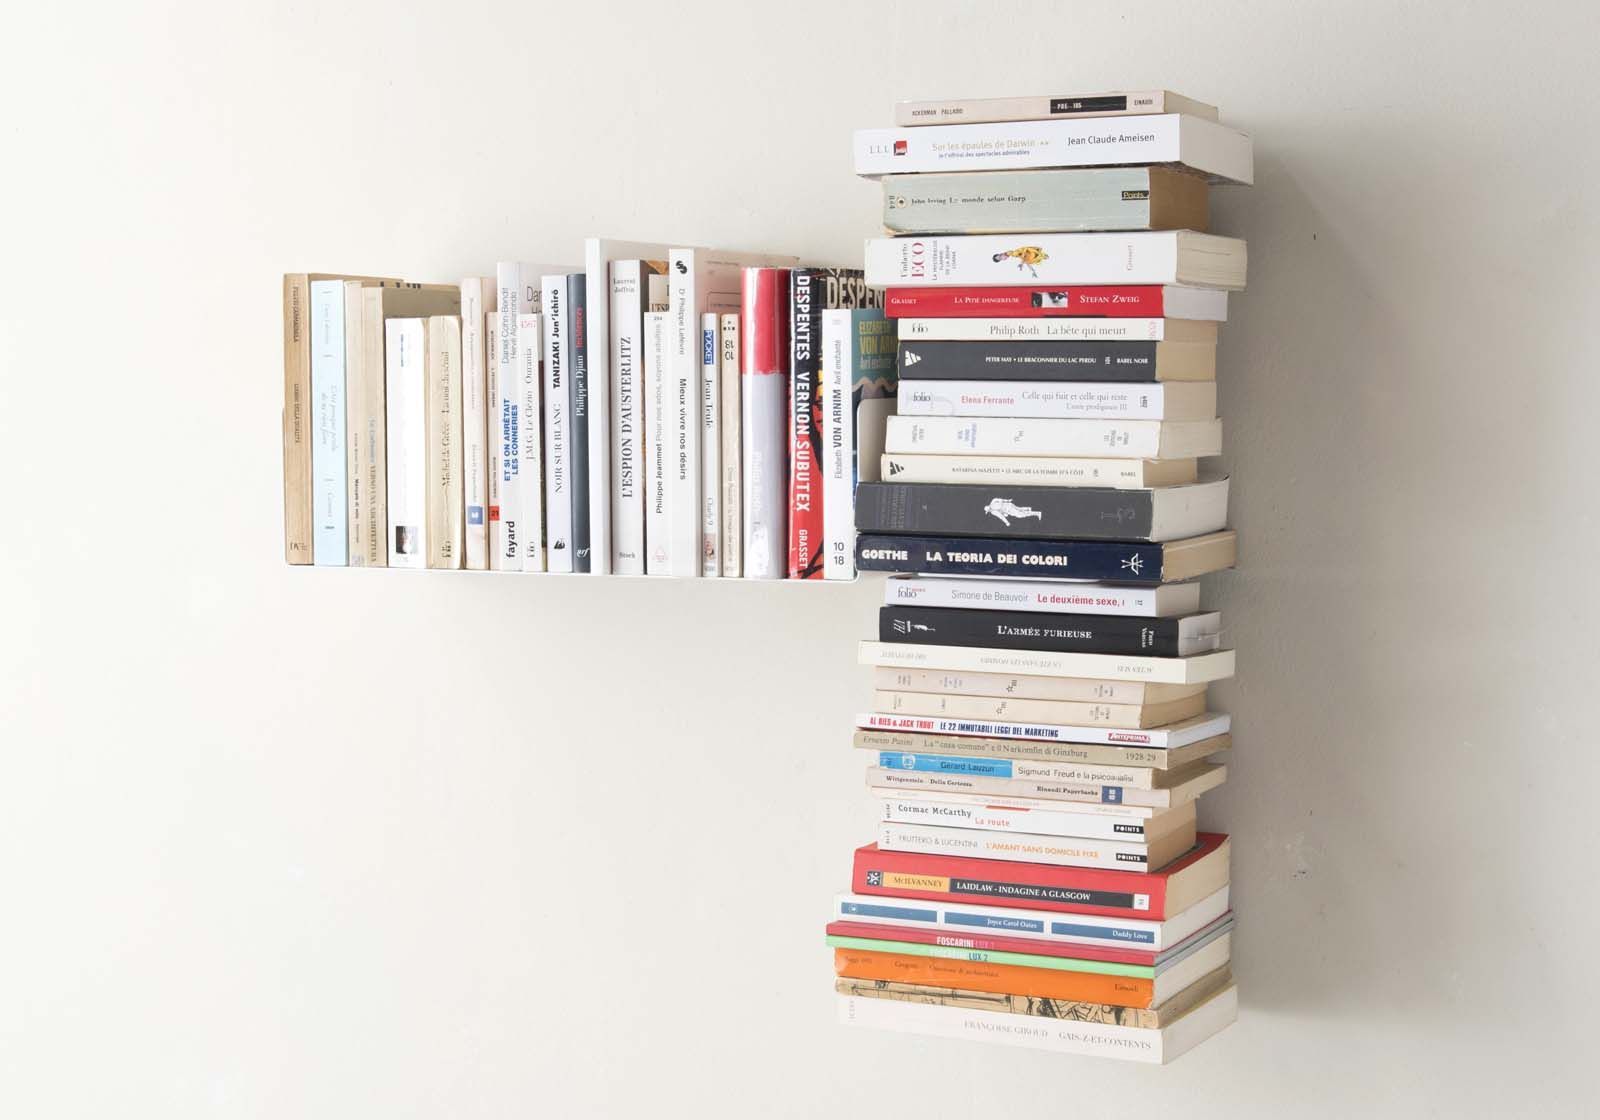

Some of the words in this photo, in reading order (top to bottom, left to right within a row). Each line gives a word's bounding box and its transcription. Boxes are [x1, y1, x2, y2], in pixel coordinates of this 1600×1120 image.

[932, 143, 944, 152] Sur
[948, 142, 960, 151] les
[961, 140, 993, 152] épaules
[995, 140, 1005, 149] de
[1007, 139, 1035, 149] Darwin
[1068, 136, 1086, 146] Jean
[1088, 135, 1117, 145] Claude
[1119, 133, 1155, 143] Ameisen
[911, 197, 926, 205] John
[987, 195, 1005, 203] selon
[1007, 194, 1027, 203] Garp
[911, 242, 925, 277] ECO
[1079, 294, 1109, 304] STEFAN
[1112, 294, 1141, 304] ZWEIG
[501, 287, 509, 338] Cohn-Bendit
[677, 297, 686, 326] Philippe
[796, 275, 810, 361] DESPENTES
[990, 324, 1014, 337] Philip
[1016, 324, 1040, 336] Roth
[1047, 325, 1057, 336] La
[1058, 324, 1079, 336] bête
[1080, 325, 1098, 338] qui
[1098, 326, 1127, 336] meurt
[678, 327, 687, 355] Lefèvre
[704, 329, 714, 366] POCKET
[501, 338, 509, 364] Daniel
[551, 341, 561, 389] TANIZAKI
[574, 355, 586, 379] Djian
[985, 356, 1002, 364] PETER
[1003, 356, 1013, 364] MAY
[619, 336, 632, 434] D'AUSTERLITZ
[679, 378, 688, 406] Mieux
[704, 378, 714, 401] Jean
[575, 380, 587, 417] Philippe
[796, 372, 810, 436] VERNON
[912, 391, 931, 403] folio
[961, 394, 983, 405] Elena
[983, 395, 1015, 405] Ferrante
[1021, 390, 1041, 401] Celle
[1041, 392, 1053, 403] qui
[1053, 391, 1069, 401] fuit
[1070, 392, 1078, 401] et
[1078, 391, 1095, 402] celle
[1096, 393, 1109, 403] qui
[1110, 393, 1128, 402] reste
[832, 388, 842, 424] ARNIM
[502, 398, 511, 441] ARRÊTAIT
[525, 420, 534, 431] Le
[552, 403, 562, 440] BLANC
[679, 407, 688, 430] vivre
[511, 404, 519, 456] CONNERIES
[832, 427, 842, 448] VON
[679, 432, 687, 450] nos
[503, 443, 511, 457] ON
[554, 443, 562, 465] SUR
[503, 459, 511, 468] SI
[511, 458, 519, 475] LES
[620, 437, 633, 498] L'ESPION
[655, 444, 663, 480] Jeammet
[679, 451, 689, 481] désirs
[834, 448, 843, 479] Elizabeth
[503, 470, 511, 481] ET
[554, 467, 563, 493] NOIR
[796, 440, 810, 513] SUBUTEX
[655, 481, 663, 514] Philippe
[505, 520, 518, 558] fayard
[833, 542, 845, 552] 10
[618, 551, 636, 560] Stock
[798, 529, 808, 569] GRASSET
[862, 549, 908, 561] GOETHE
[833, 555, 845, 565] 18
[926, 551, 943, 563] LA
[947, 552, 993, 564] TEORIA
[997, 553, 1017, 565] DEI
[1021, 554, 1067, 567] COLORI
[897, 587, 918, 599] folio
[951, 590, 980, 601] Simone
[982, 591, 993, 602] de
[994, 592, 1029, 603] Beauvoir
[1038, 593, 1048, 604] Le
[1050, 594, 1094, 606] deuxième
[1096, 596, 1120, 608] sexe,
[997, 624, 1041, 637] L'ARMÉE
[1044, 628, 1092, 640] FURIEUSE
[869, 716, 877, 725] AL
[878, 717, 891, 726] RIES
[892, 719, 897, 727] &
[898, 719, 914, 728] JACK
[916, 720, 935, 730] TROUT
[939, 722, 947, 730] LE
[948, 722, 957, 731] 22
[957, 723, 994, 734] IMMUTABILI
[994, 725, 1011, 735] LEGGI
[1012, 726, 1023, 735] DEL
[1024, 727, 1060, 738] MARKETING
[863, 736, 889, 746] Ernesto
[924, 739, 934, 748] La
[1044, 746, 1052, 756] di
[1053, 748, 1088, 759] Ginzburg
[1018, 766, 1051, 779] Sigmund
[1054, 768, 1076, 780] Freud
[1084, 770, 1091, 780] la
[1091, 772, 1134, 785] psicoanalisi
[1037, 785, 1062, 793] Einaudi
[1063, 787, 1099, 797] Paperbacks
[898, 804, 929, 815] Cormac
[932, 807, 972, 819] McCarthy
[974, 817, 984, 825] La
[987, 818, 1010, 828] route
[1116, 825, 1140, 834] POINTS
[898, 834, 933, 845] FRUTTERO
[934, 838, 940, 846] &
[941, 838, 978, 848] LUCENTINI
[985, 842, 1020, 852] L'AMANT
[1022, 844, 1043, 854] SANS
[1044, 846, 1081, 857] DOMICILE
[1083, 849, 1100, 859] FIXE
[1117, 854, 1141, 862] POINTS
[894, 876, 944, 889] McILVANNEY
[956, 881, 993, 893] LAIDLAW
[998, 885, 1040, 897] INDAGINE
[1041, 890, 1048, 898] A
[1048, 891, 1091, 901] GLASGOW
[987, 917, 1002, 927] Joyce
[1002, 919, 1019, 928] Carol
[1019, 920, 1037, 930] Oates
[936, 936, 974, 949] FOSCARINI
[975, 939, 990, 950] LUX
[1112, 930, 1133, 940] Daddy
[1134, 931, 1148, 940] Love
[968, 952, 982, 962] LUX
[982, 953, 989, 963] 2
[963, 1020, 1012, 1034] FRANÇOISE
[1014, 1026, 1049, 1038] GIROUD
